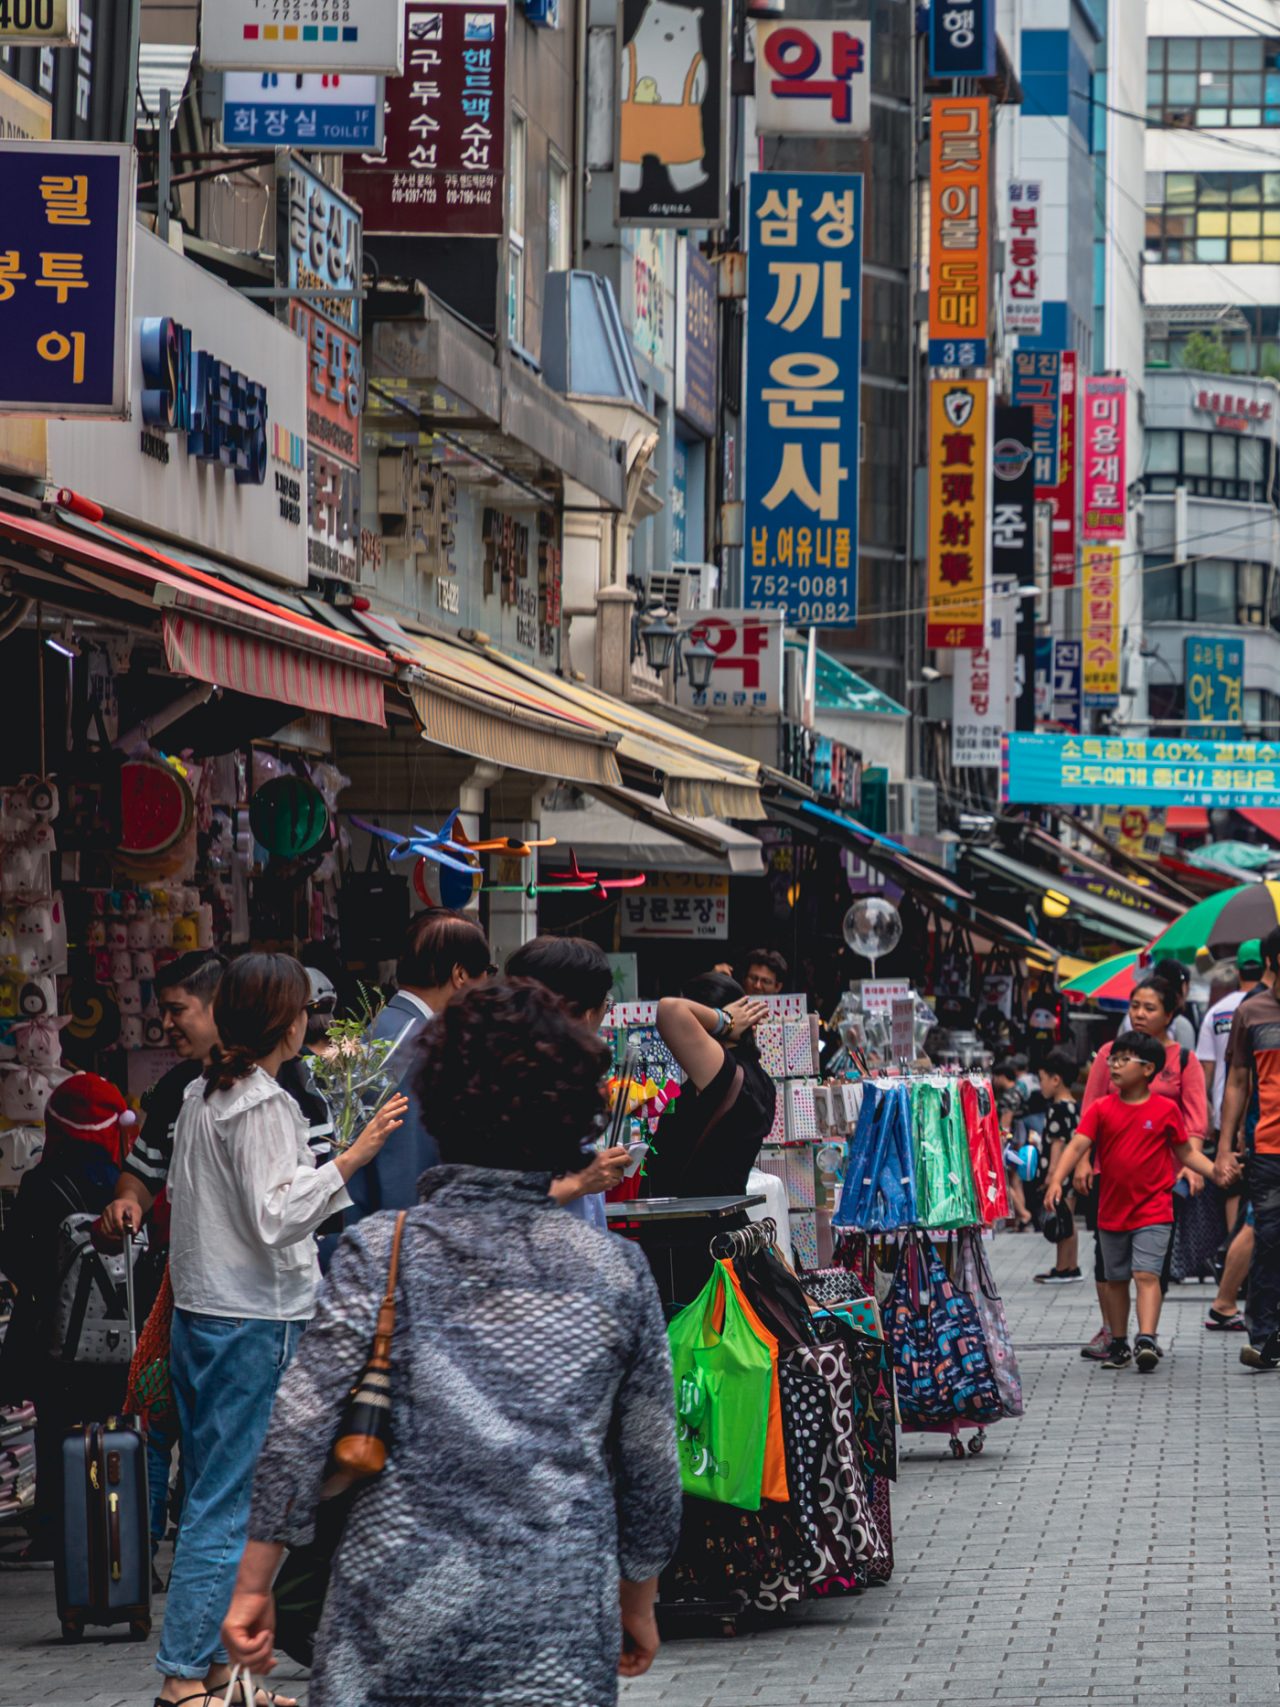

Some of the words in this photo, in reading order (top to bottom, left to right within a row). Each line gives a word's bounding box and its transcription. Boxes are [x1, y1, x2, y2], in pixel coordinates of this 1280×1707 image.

[764, 28, 863, 122] 약
[233, 108, 318, 137] 화장실
[355, 110, 369, 122] 1F
[323, 125, 369, 138] TOILET
[941, 107, 980, 172] 그릇
[756, 187, 855, 249] 삼성
[1010, 206, 1039, 298] 부동산
[938, 263, 978, 328] 도매
[943, 343, 976, 366] 3층
[760, 262, 851, 521] 까운사
[1090, 399, 1121, 510] 미용재료
[751, 575, 849, 597] 752-0081
[945, 628, 967, 646] 4F
[690, 617, 769, 688] 약
[1062, 740, 1146, 760] 소득공제
[1061, 765, 1147, 786] 모두에게
[625, 896, 714, 923] 남문포장
